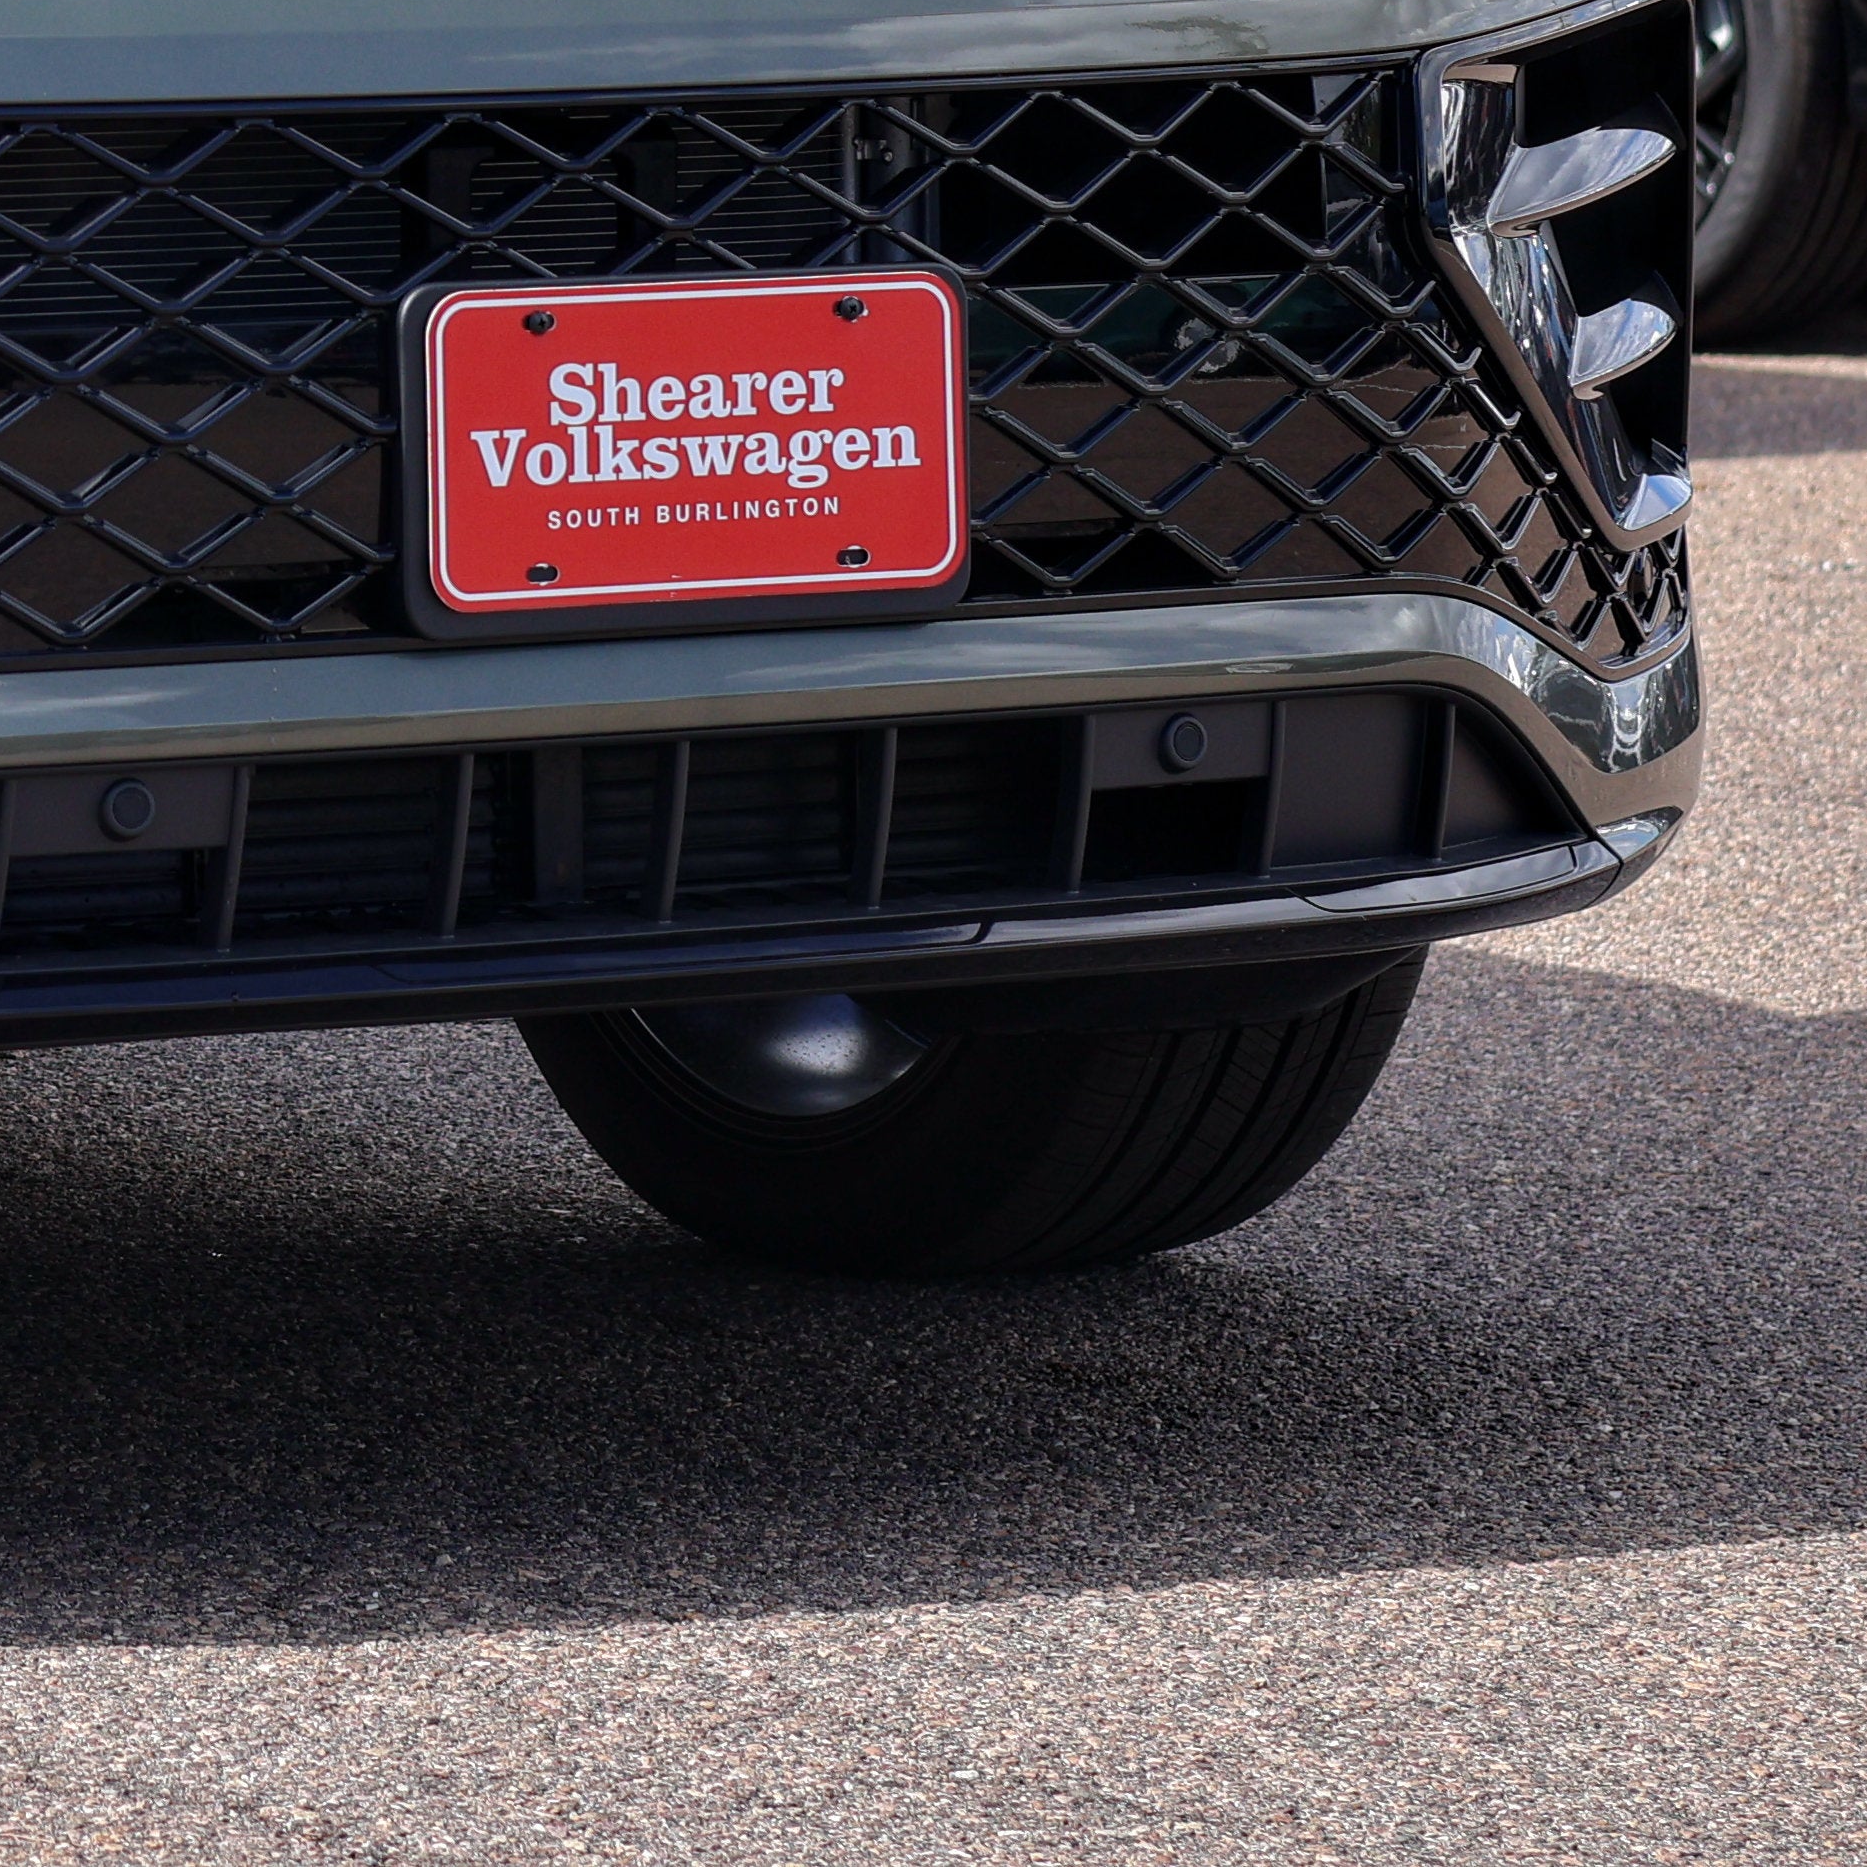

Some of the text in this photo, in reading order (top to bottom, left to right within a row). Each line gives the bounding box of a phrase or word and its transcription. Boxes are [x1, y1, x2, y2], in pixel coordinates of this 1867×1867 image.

[548, 361, 845, 427] Shearer
[469, 422, 922, 490] Volkswagen
[546, 495, 841, 531] SOUTH BURLINGTON
